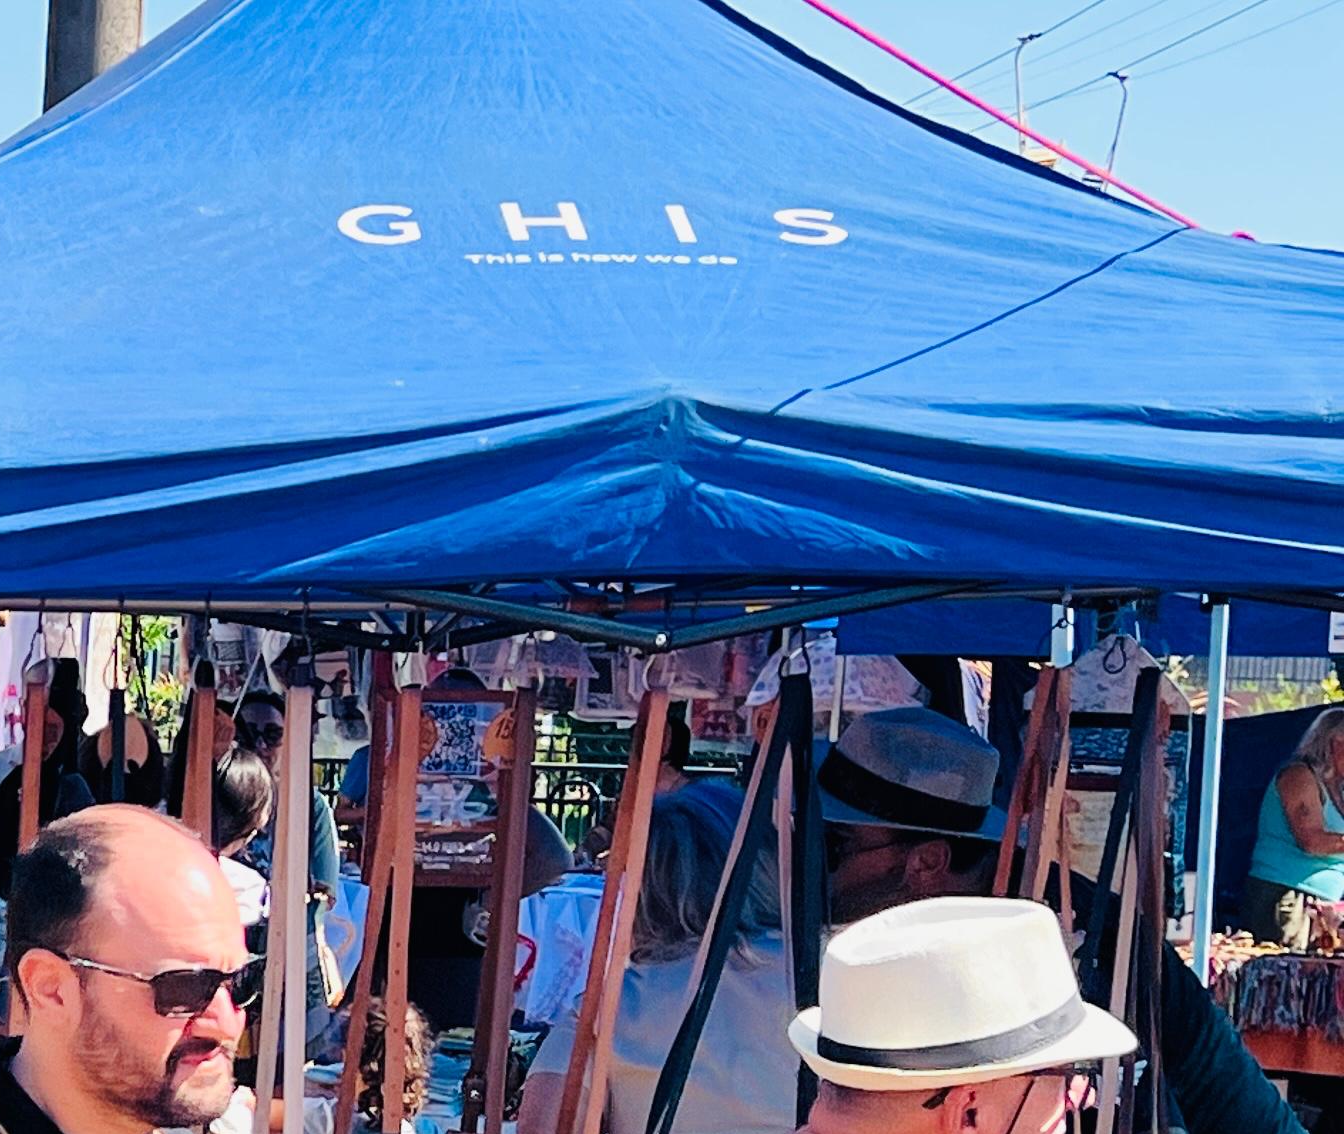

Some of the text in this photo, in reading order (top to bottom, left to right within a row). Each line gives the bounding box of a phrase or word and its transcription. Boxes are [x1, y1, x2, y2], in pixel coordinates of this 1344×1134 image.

[337, 202, 848, 245] GHIS
[464, 251, 739, 265] This is how we do
